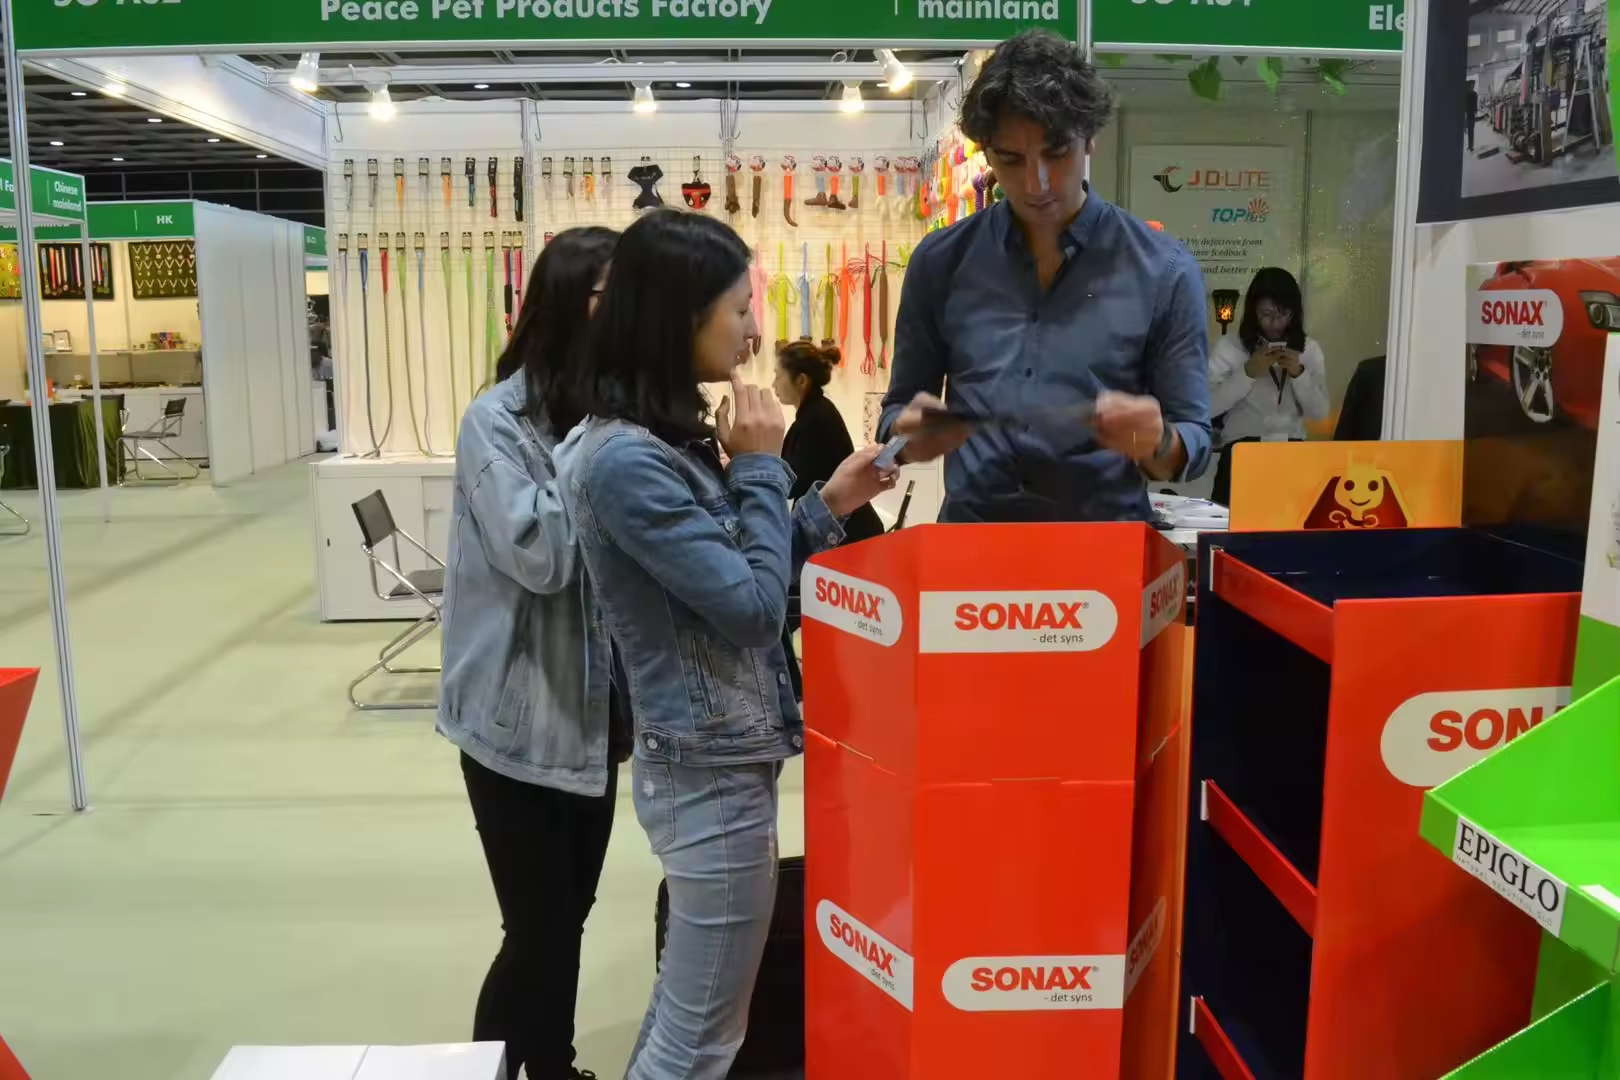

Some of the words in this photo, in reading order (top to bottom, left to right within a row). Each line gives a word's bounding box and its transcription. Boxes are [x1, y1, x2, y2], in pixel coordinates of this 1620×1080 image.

[321, 0, 419, 20] Peace
[432, 0, 484, 18] Pet
[496, 0, 640, 18] Products
[652, 0, 772, 24] Factory
[918, 0, 1058, 19] mainland
[156, 214, 174, 224] HK
[1210, 248, 1248, 257] feedback
[1220, 266, 1248, 274] better
[1481, 300, 1544, 326] SONAX
[816, 576, 881, 622] SONAX
[954, 602, 1082, 630] SONAX
[1040, 634, 1057, 642] det
[1060, 634, 1084, 644] syns
[1456, 822, 1559, 913] EPIGLO
[830, 914, 894, 978] SONAX
[970, 966, 1092, 992] SONAX
[1051, 992, 1068, 1002] det
[1070, 994, 1092, 1003] syns
